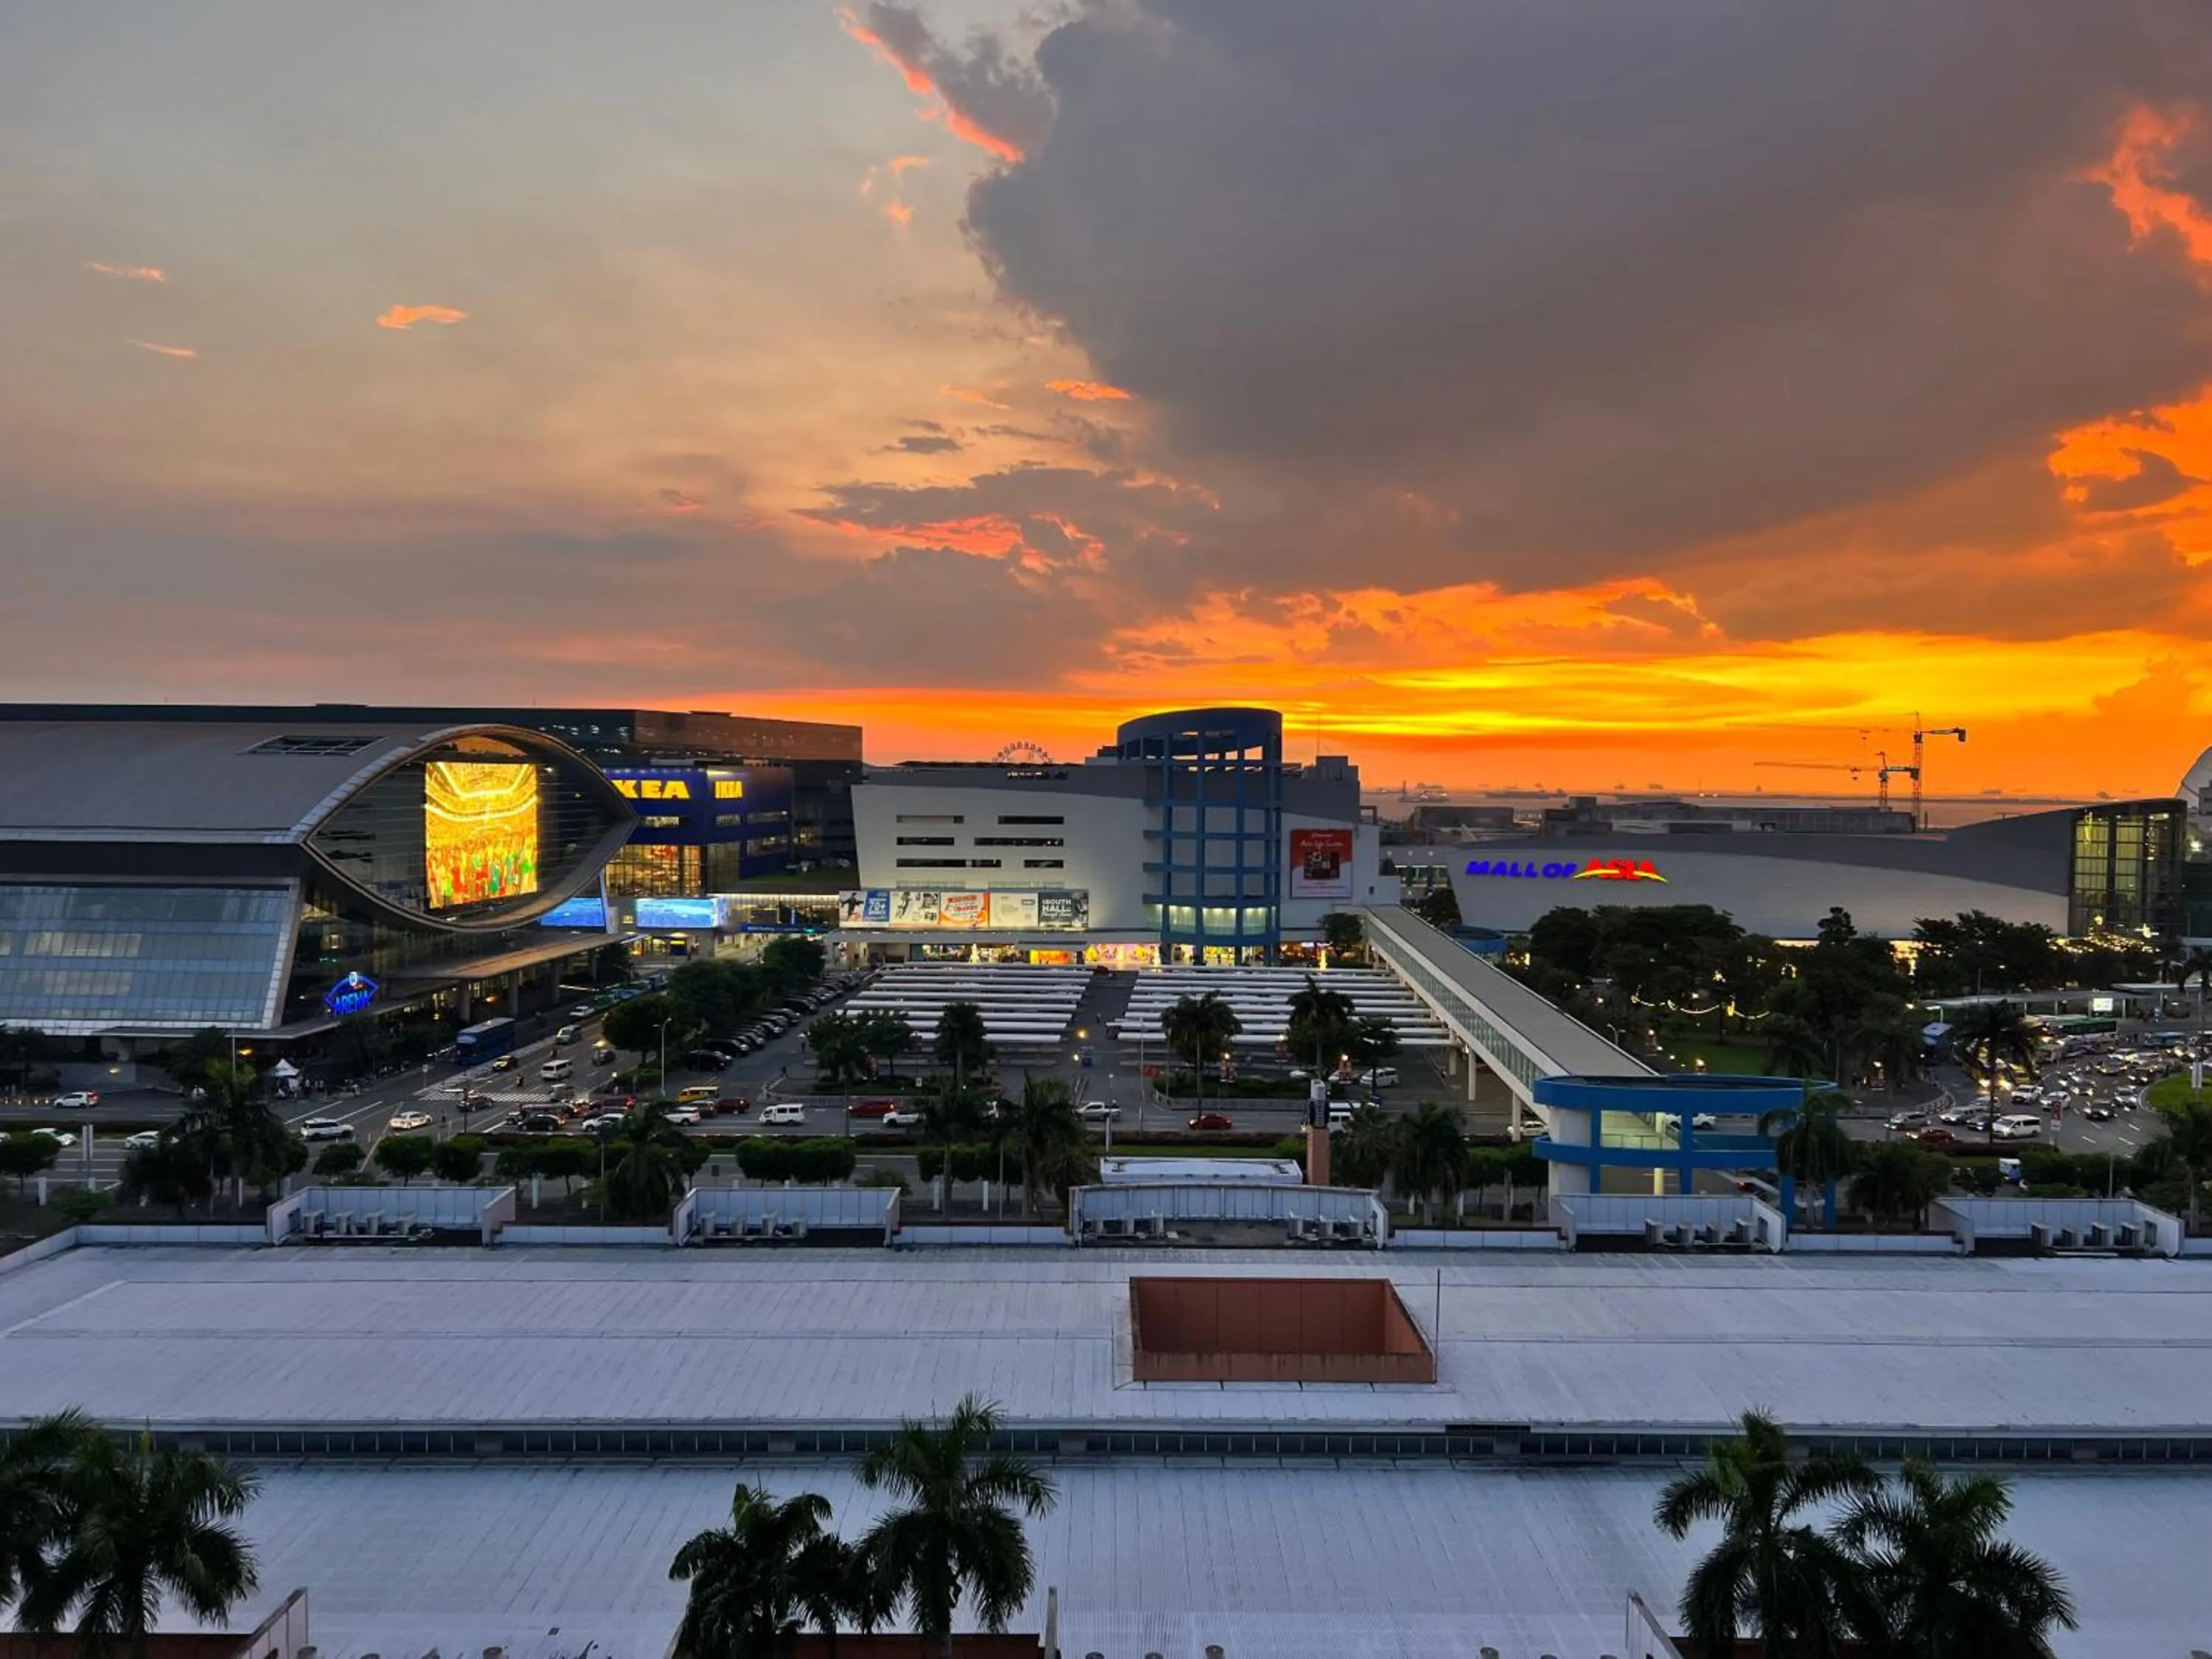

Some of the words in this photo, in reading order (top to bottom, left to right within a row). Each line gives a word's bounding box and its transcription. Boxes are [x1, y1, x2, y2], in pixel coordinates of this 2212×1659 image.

[611, 779, 690, 799] KEA
[1465, 860, 1539, 877] MALL
[1542, 863, 1577, 879] OF
[1585, 857, 1658, 880] ASIA
[333, 990, 369, 1015] ARENA
